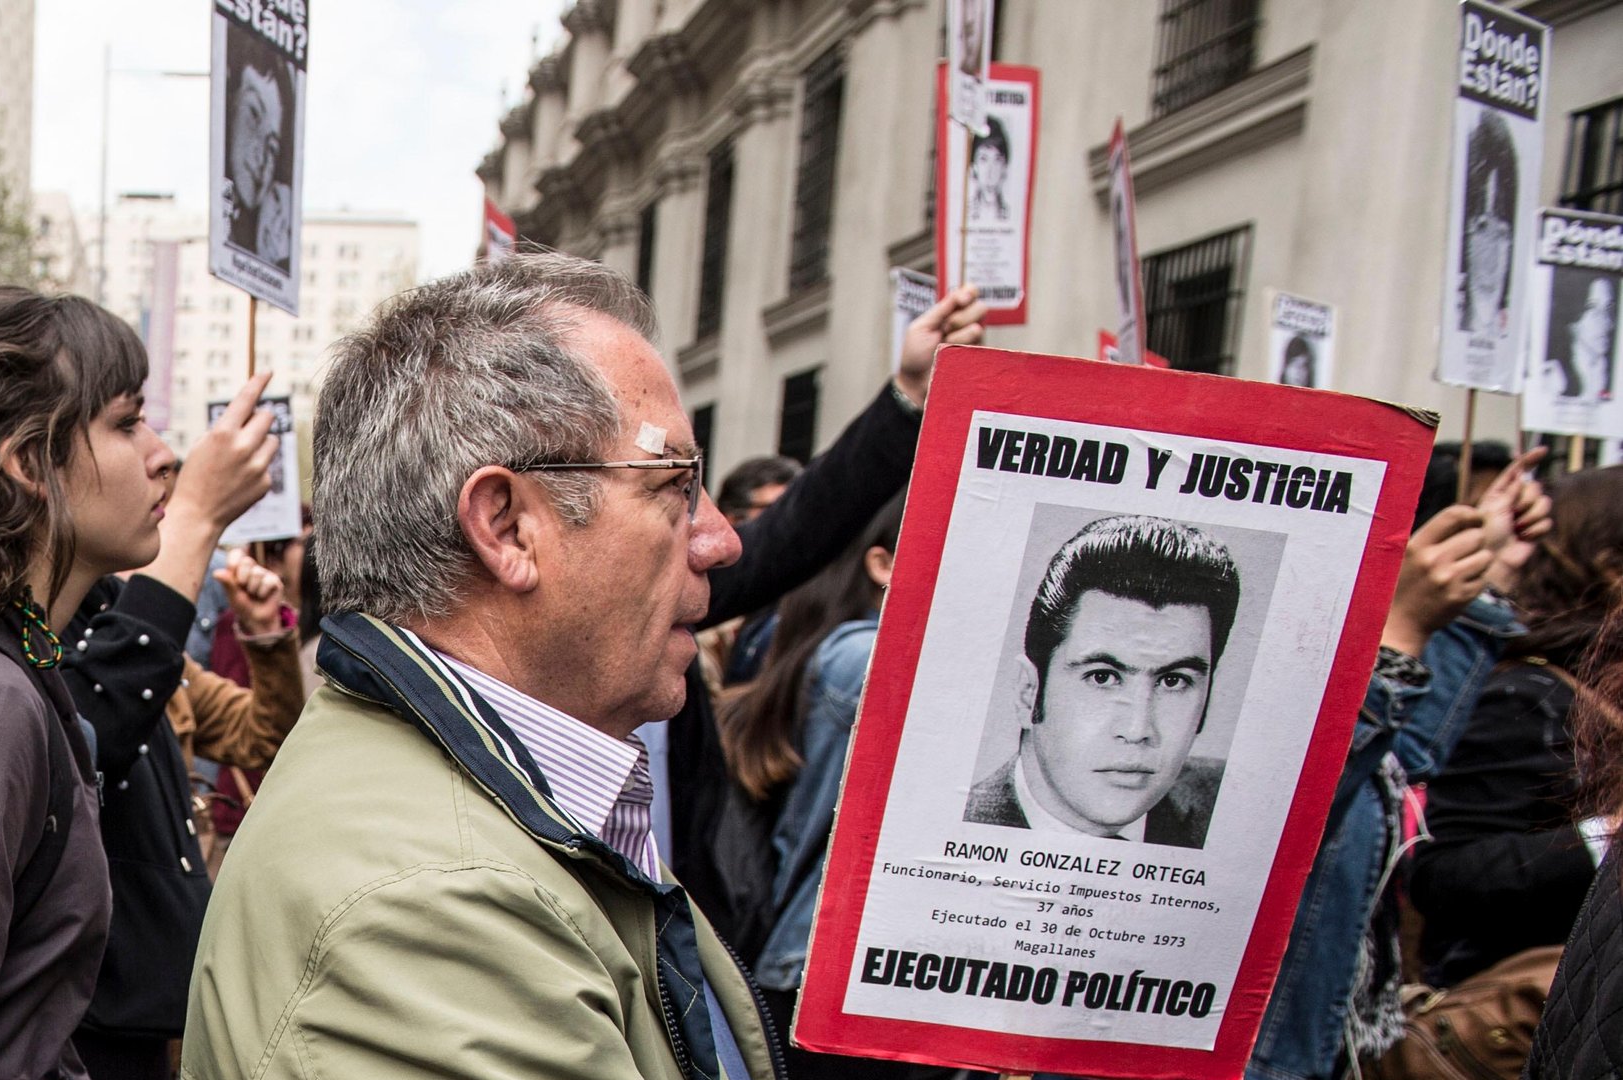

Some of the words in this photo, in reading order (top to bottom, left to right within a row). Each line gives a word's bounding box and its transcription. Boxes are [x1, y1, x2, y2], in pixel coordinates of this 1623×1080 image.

[1465, 12, 1539, 73] Dónde
[1461, 50, 1539, 109] Están?
[1543, 216, 1623, 250] Dónd
[977, 427, 1130, 485] VERDAD
[1145, 447, 1172, 490] Y
[1179, 453, 1354, 514] JUSTICIA
[883, 862, 983, 887] Funcionario,
[993, 875, 1061, 895] Servicio
[1068, 884, 1142, 904] Impuestos
[1150, 893, 1222, 914] Internos,
[943, 841, 1008, 864] RAMON
[1020, 850, 1122, 877] GONZALEZ
[1132, 862, 1206, 887] ORTEGA
[931, 909, 1007, 929] Ejecutado
[1015, 919, 1032, 932] el
[1040, 922, 1058, 935] 30
[1065, 924, 1082, 938] de
[1089, 927, 1146, 944] Octubre
[1153, 934, 1187, 949] 1973
[1037, 901, 1055, 914] 37
[1061, 904, 1094, 919] años
[1014, 939, 1097, 960] Magallanes
[860, 947, 1060, 1005] EJECUTADO
[1062, 969, 1218, 1019] POLÍTICO
